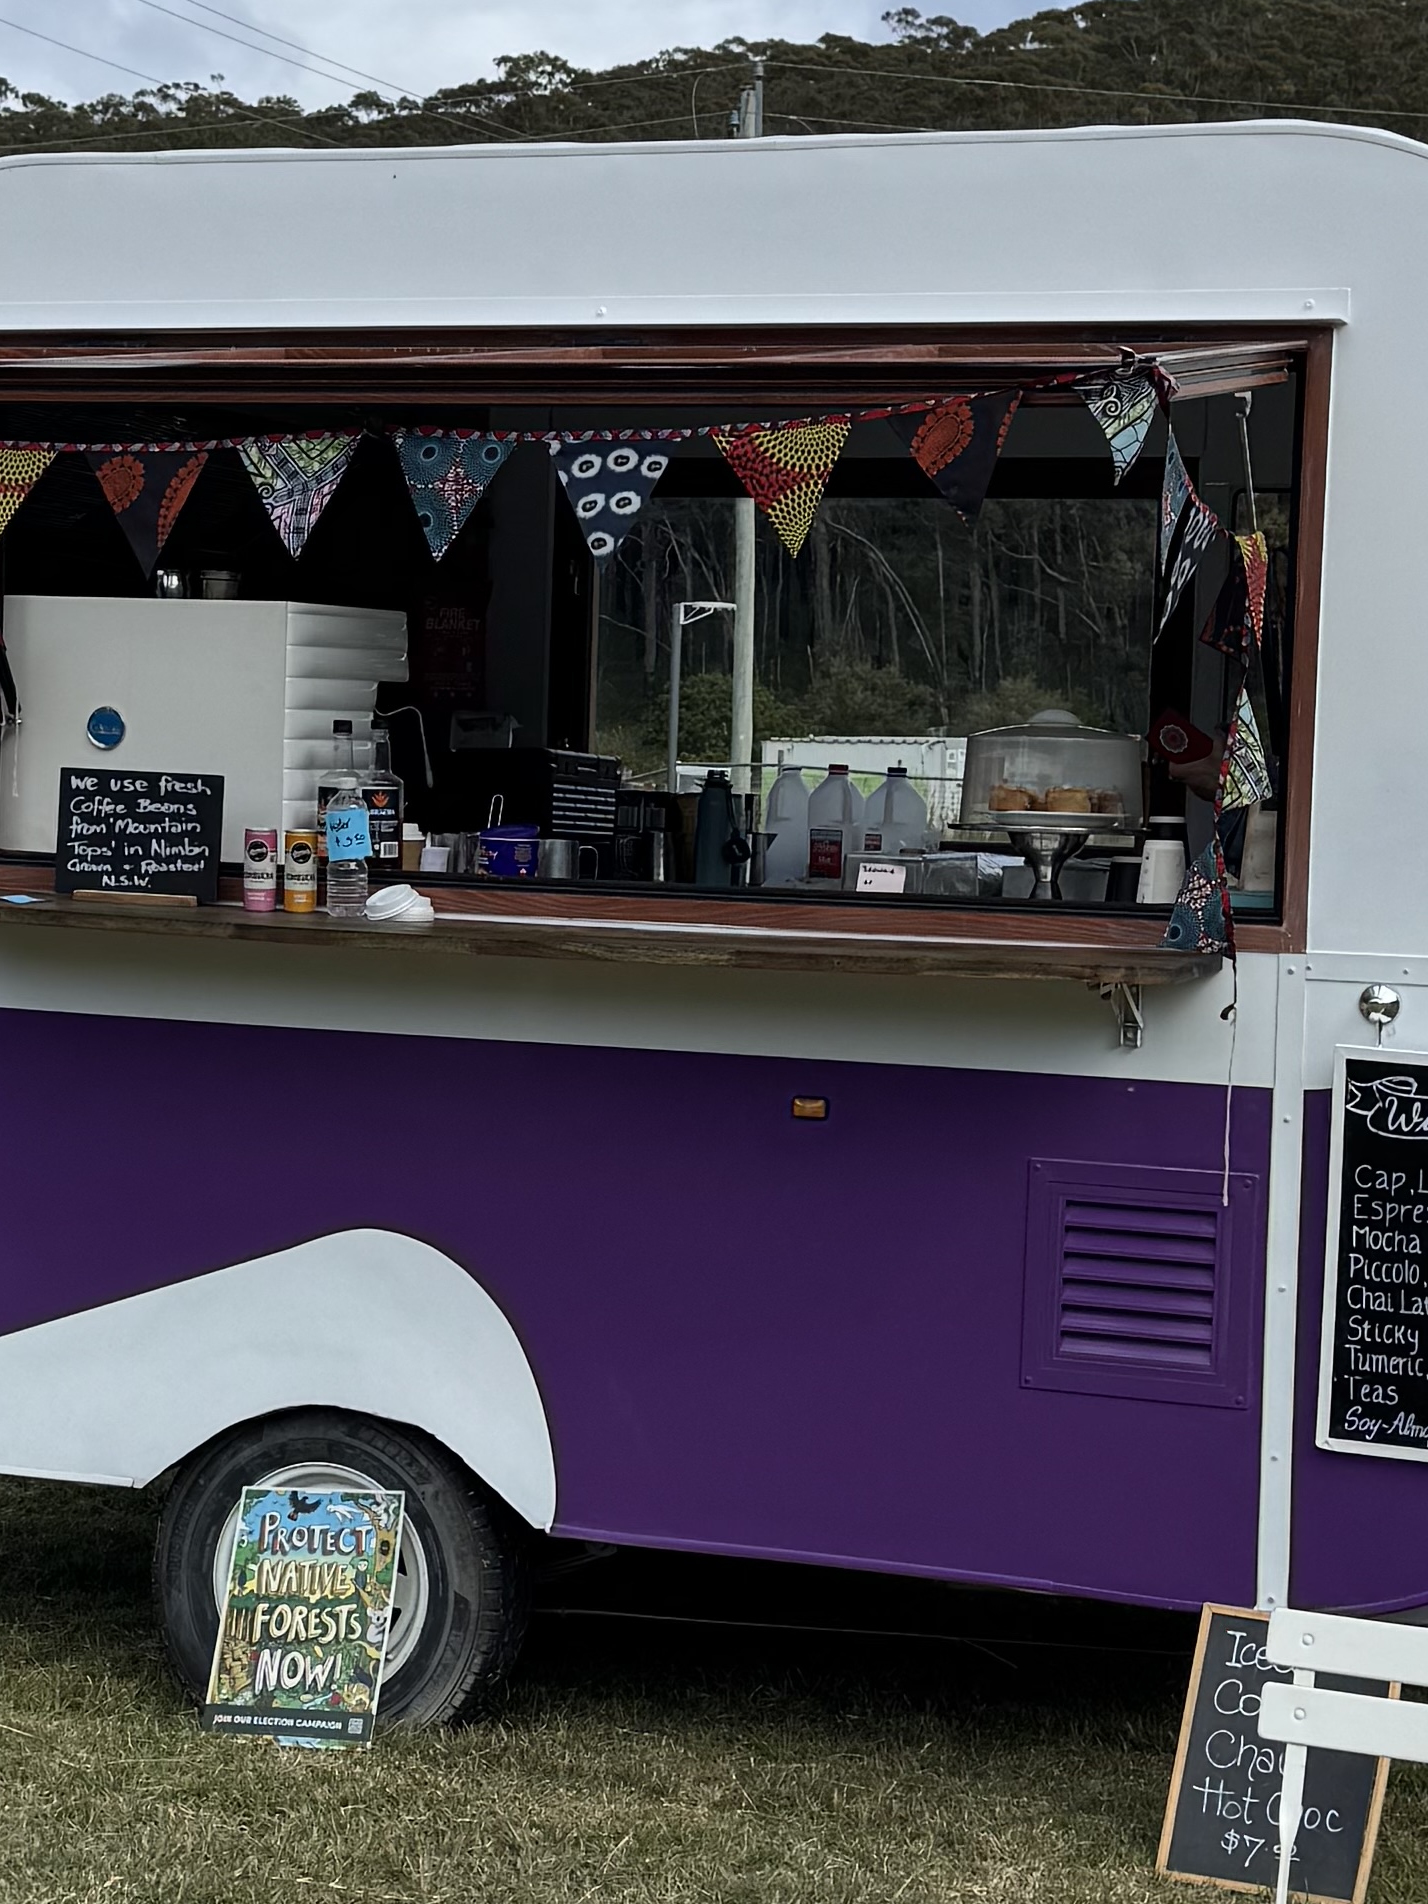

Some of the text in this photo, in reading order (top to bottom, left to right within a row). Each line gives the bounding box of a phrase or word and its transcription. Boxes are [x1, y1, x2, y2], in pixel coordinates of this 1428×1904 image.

[70, 775, 211, 796] We use fresh
[70, 796, 197, 817] Coffee Beans
[69, 816, 106, 838] from
[124, 842, 143, 856] in
[140, 859, 204, 874] Roasted
[1347, 1284, 1394, 1313] Chai
[1347, 1315, 1419, 1355] Sticky
[1344, 1374, 1399, 1405] Teas
[262, 1511, 373, 1554] PROTECT
[258, 1559, 352, 1595] NATIVE
[252, 1602, 362, 1644] FORESTS
[254, 1648, 343, 1695] NOW!
[233, 1715, 252, 1724] OUR
[253, 1716, 294, 1727] ELECTION
[295, 1719, 343, 1730] CAMPAIGN
[1193, 1777, 1344, 1833] Hot Coc
